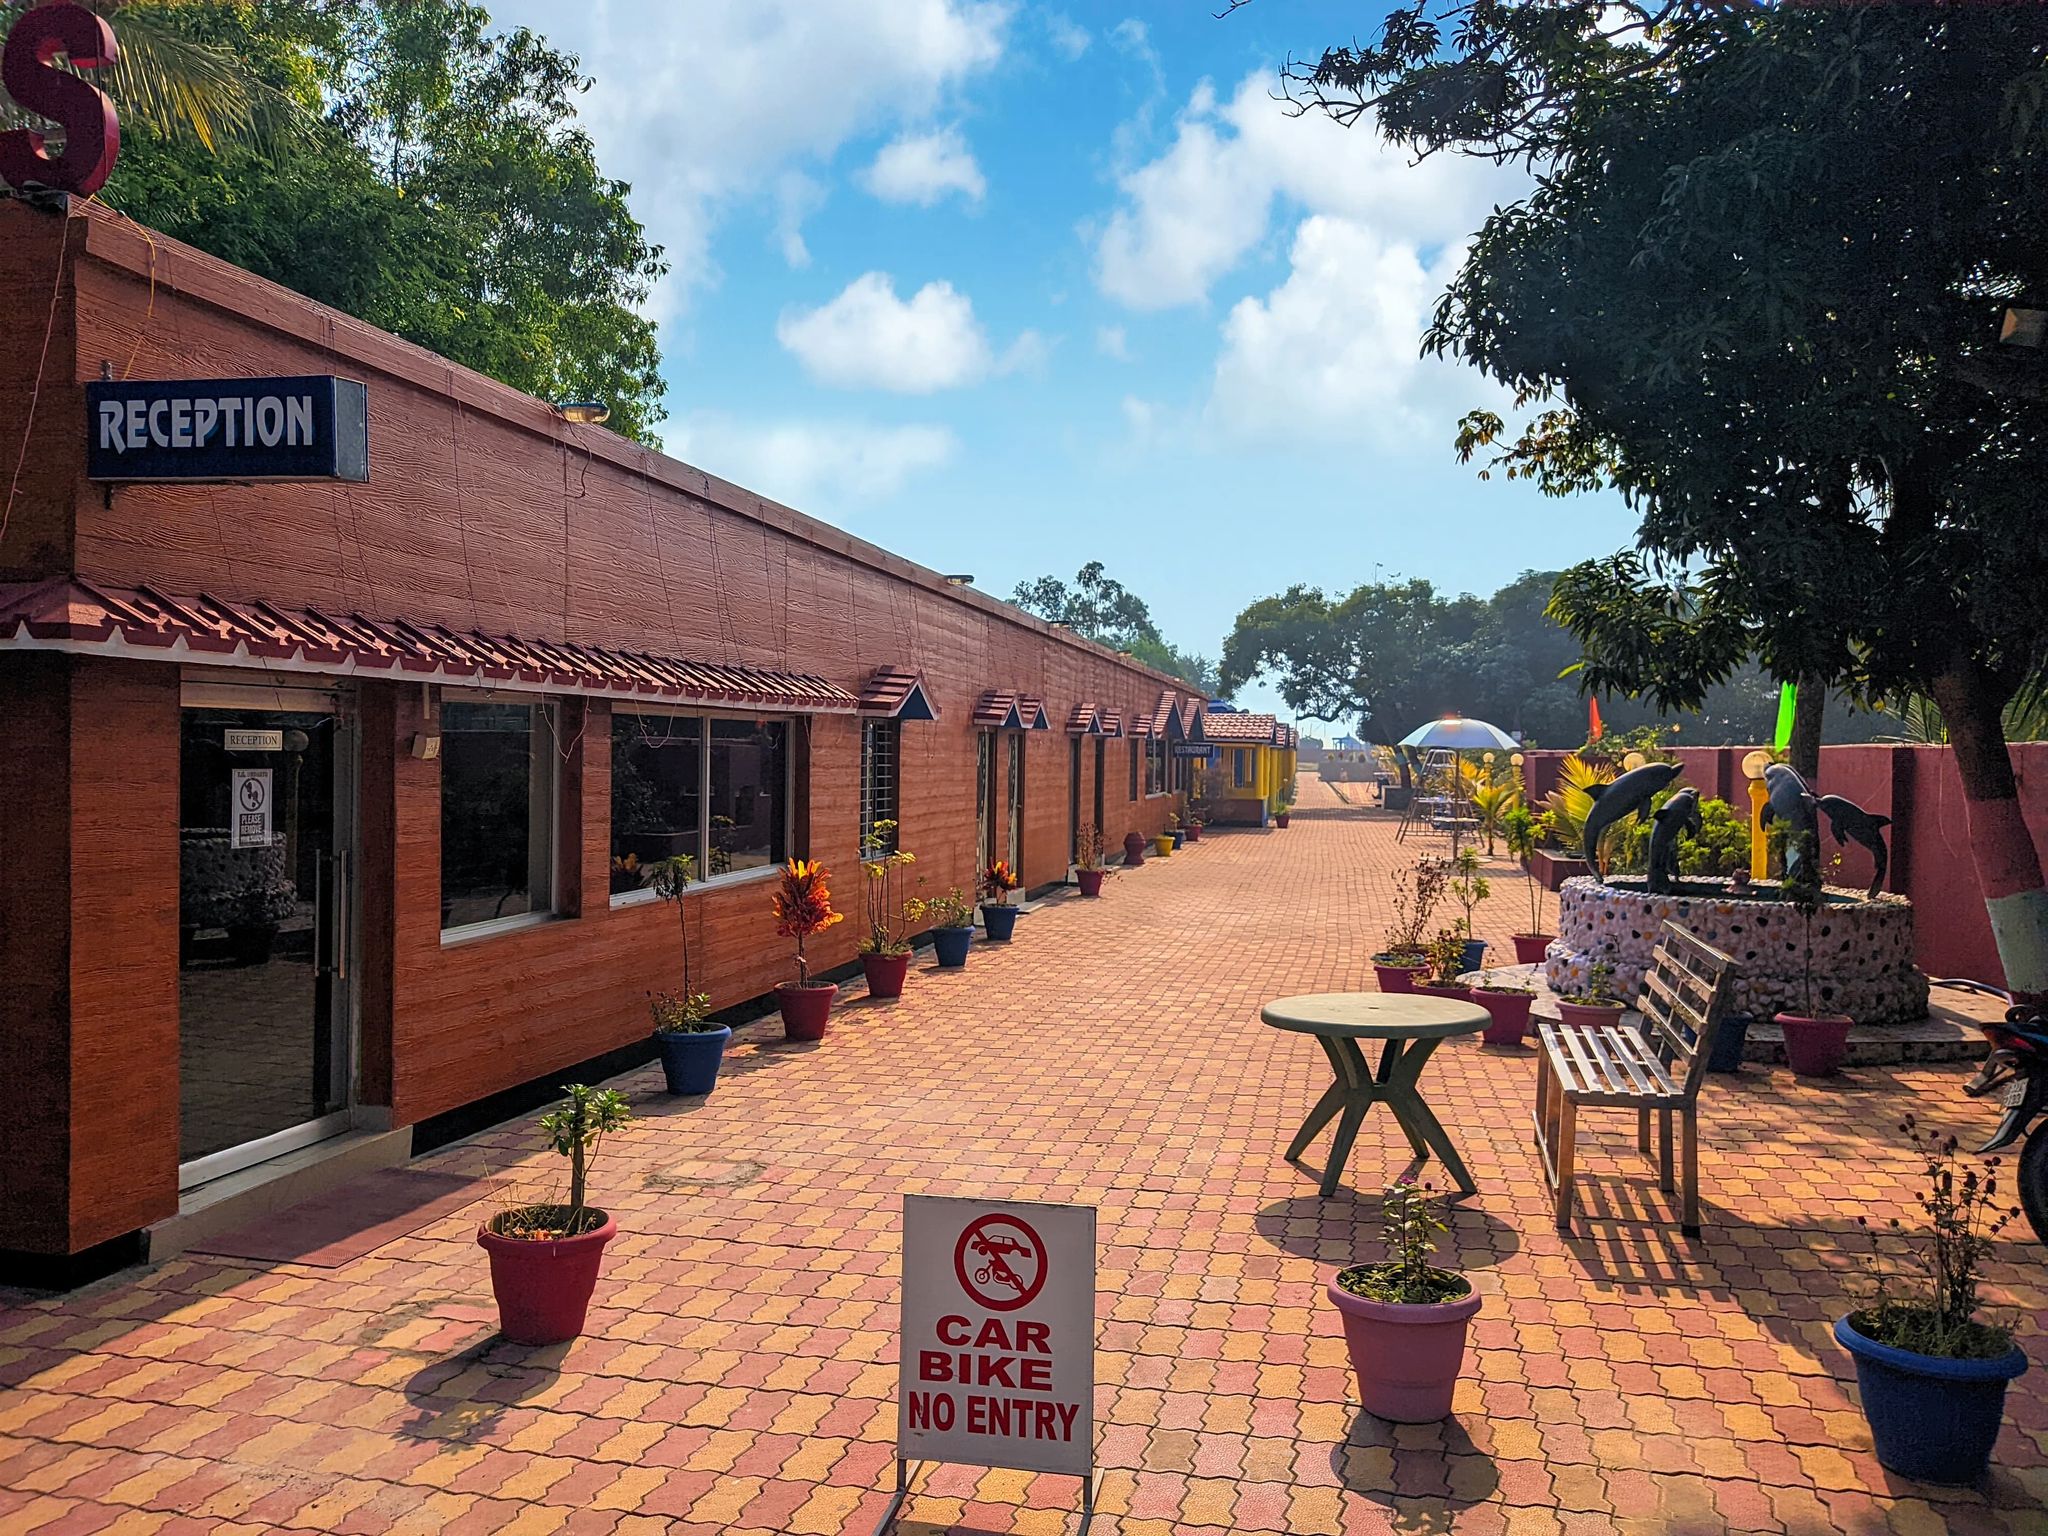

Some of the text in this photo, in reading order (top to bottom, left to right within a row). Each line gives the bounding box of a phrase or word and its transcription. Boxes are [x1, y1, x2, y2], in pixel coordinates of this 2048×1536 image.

[0, 3, 119, 197] S
[98, 395, 313, 455] RECEPTION
[230, 735, 278, 746] RECEPTION
[1175, 745, 1211, 755] RESTAURANT
[241, 814, 262, 825] PLEASE
[935, 1314, 1053, 1355] CAR
[919, 1350, 1053, 1392] BIKE
[908, 1391, 1080, 1442] NO ENTRY
